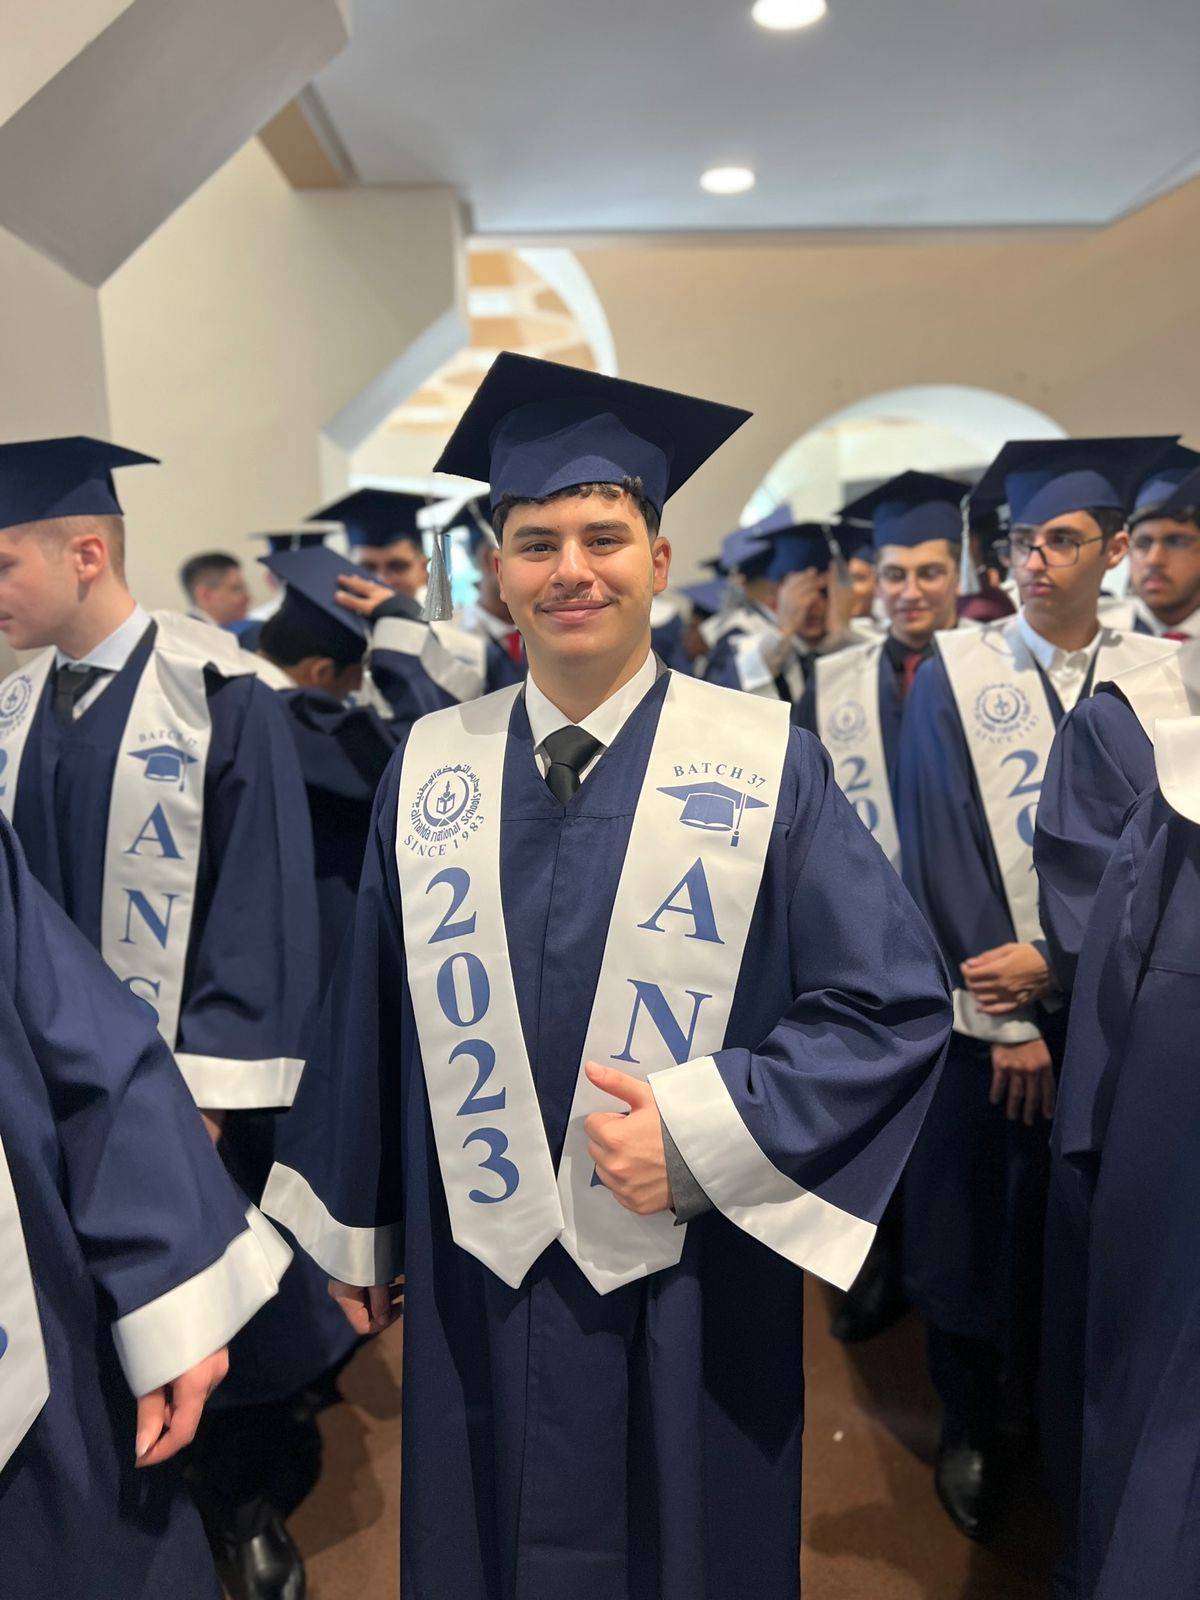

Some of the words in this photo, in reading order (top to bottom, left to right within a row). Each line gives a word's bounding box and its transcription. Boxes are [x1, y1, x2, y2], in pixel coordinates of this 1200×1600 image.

[673, 762, 744, 779] BATCH
[747, 773, 767, 788] 37
[404, 834, 447, 857] SINCE
[453, 814, 485, 849] 1983
[425, 867, 521, 1205] 2023
